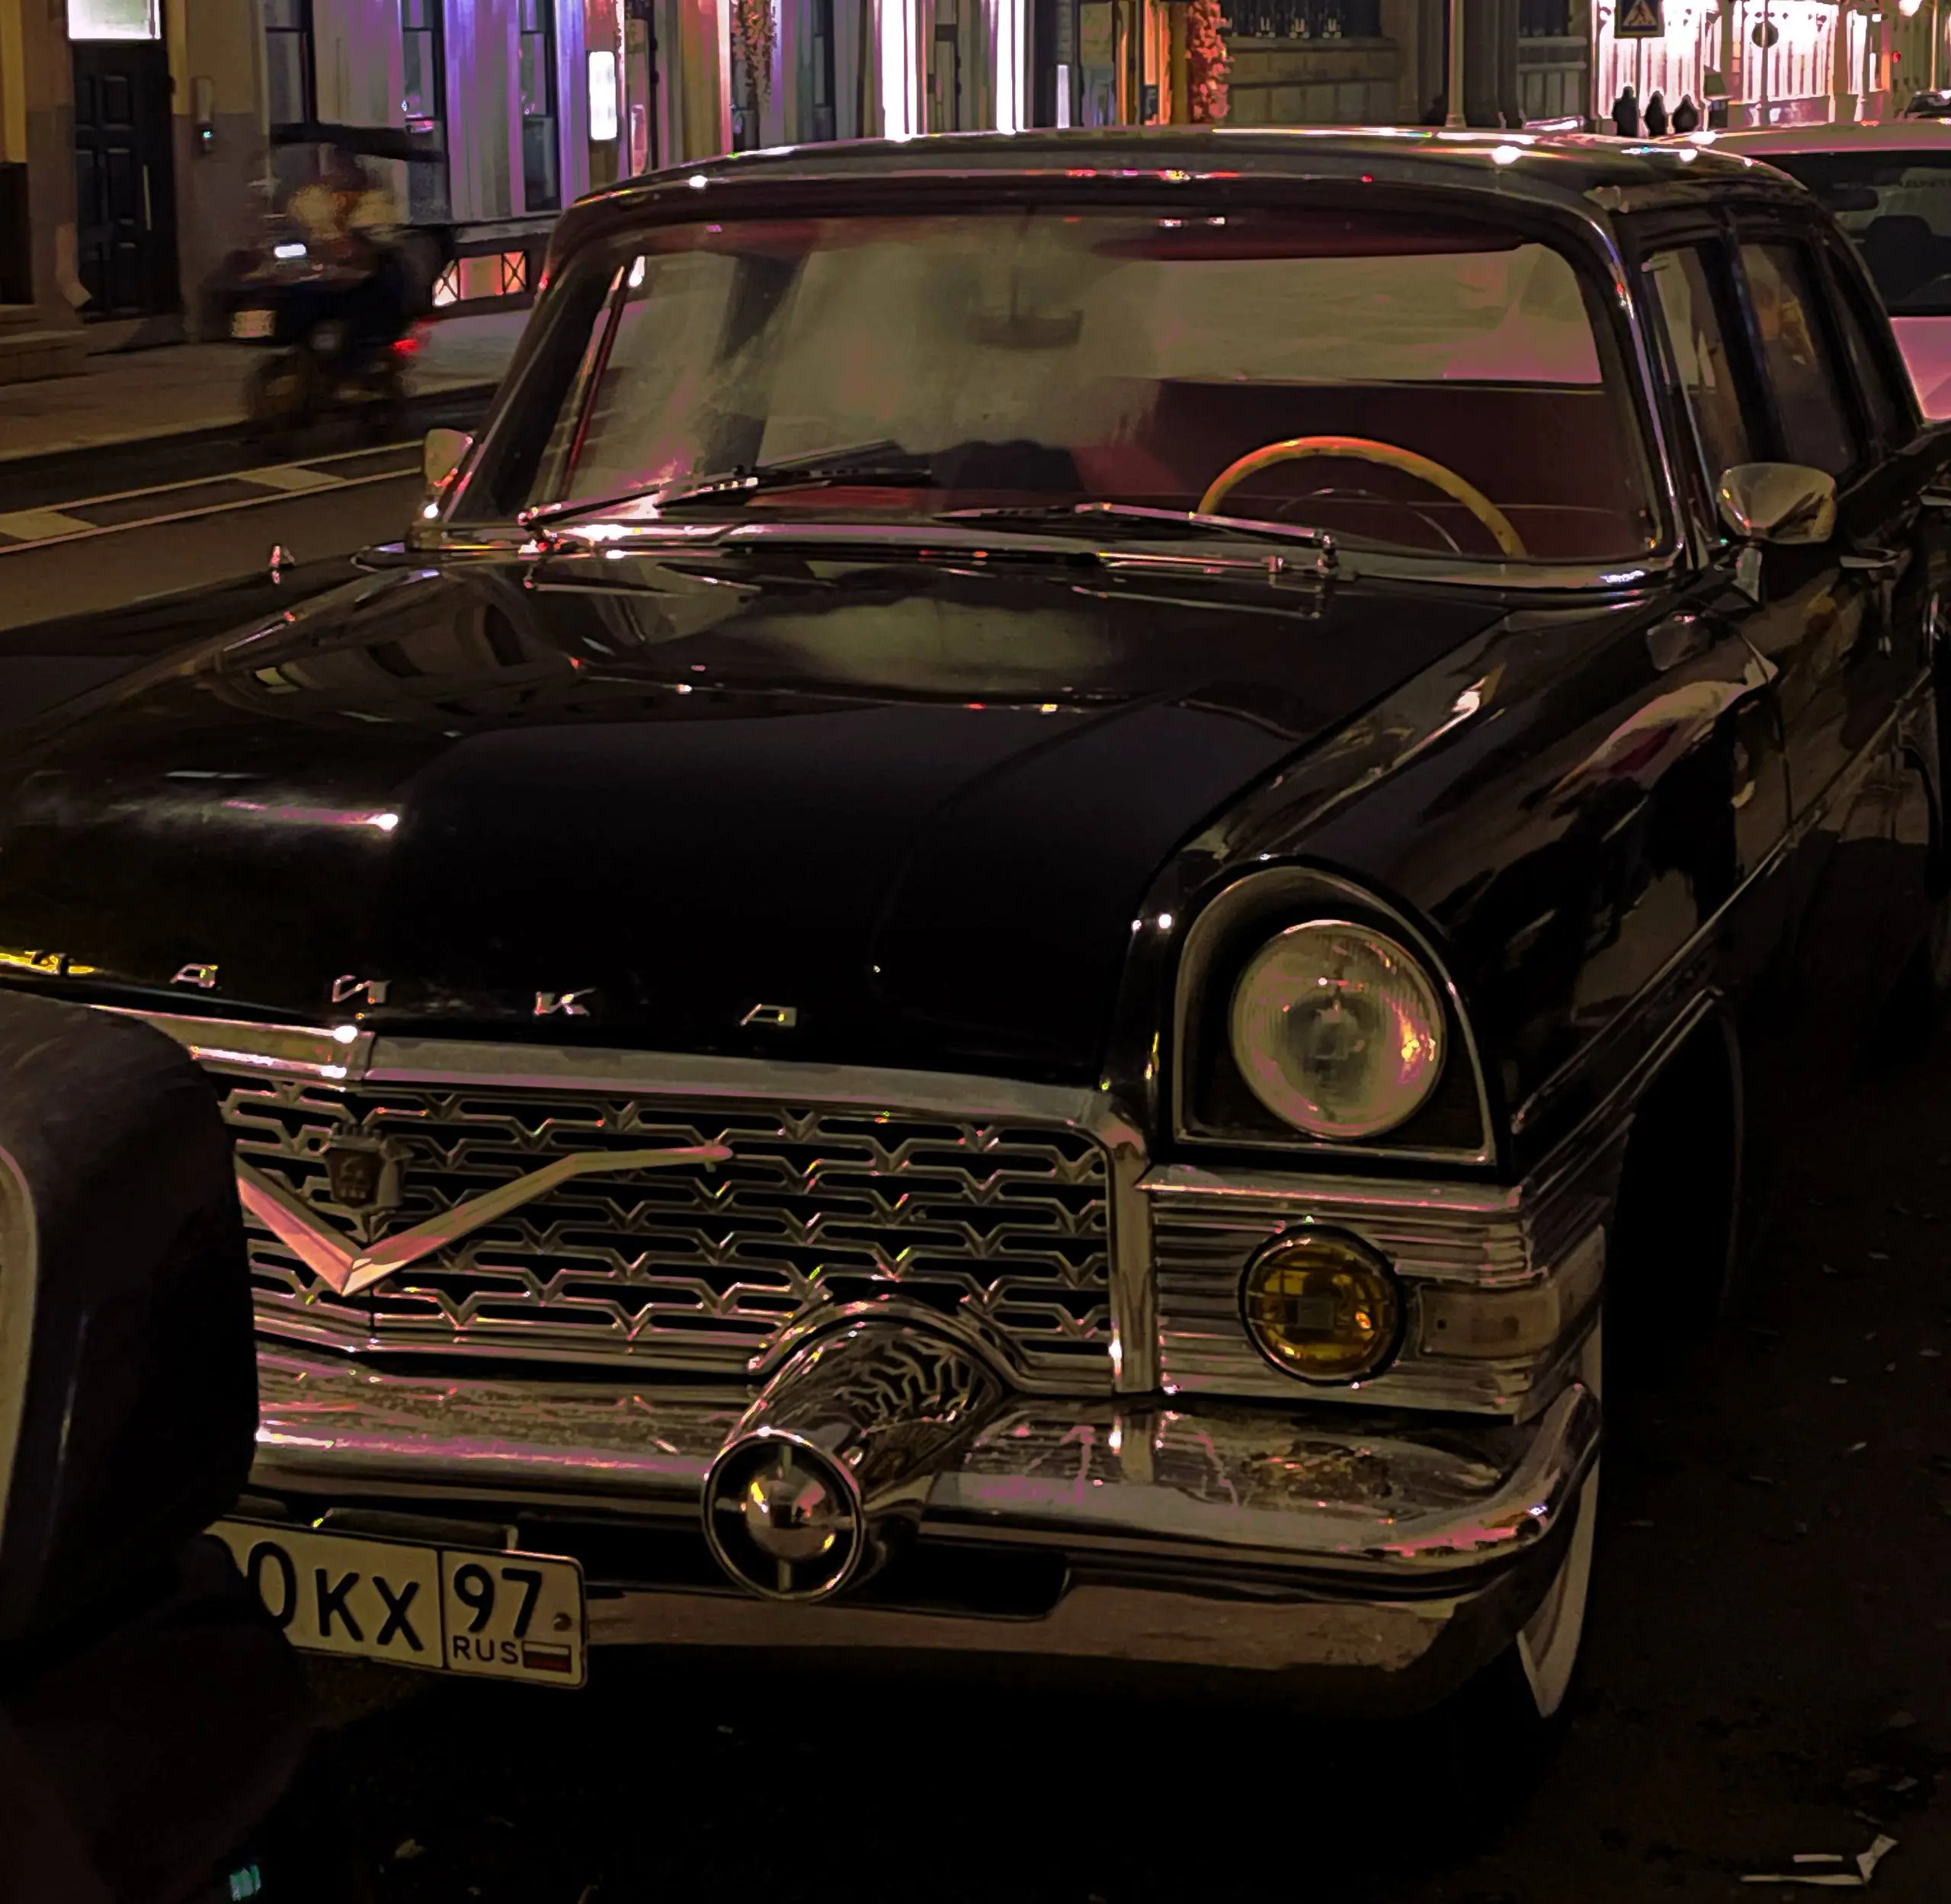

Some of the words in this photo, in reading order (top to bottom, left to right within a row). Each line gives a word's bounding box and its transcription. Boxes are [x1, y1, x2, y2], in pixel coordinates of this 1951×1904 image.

[204, 1534, 424, 1652] 0KX
[453, 1563, 543, 1638] 97
[453, 1636, 518, 1665] RUS
